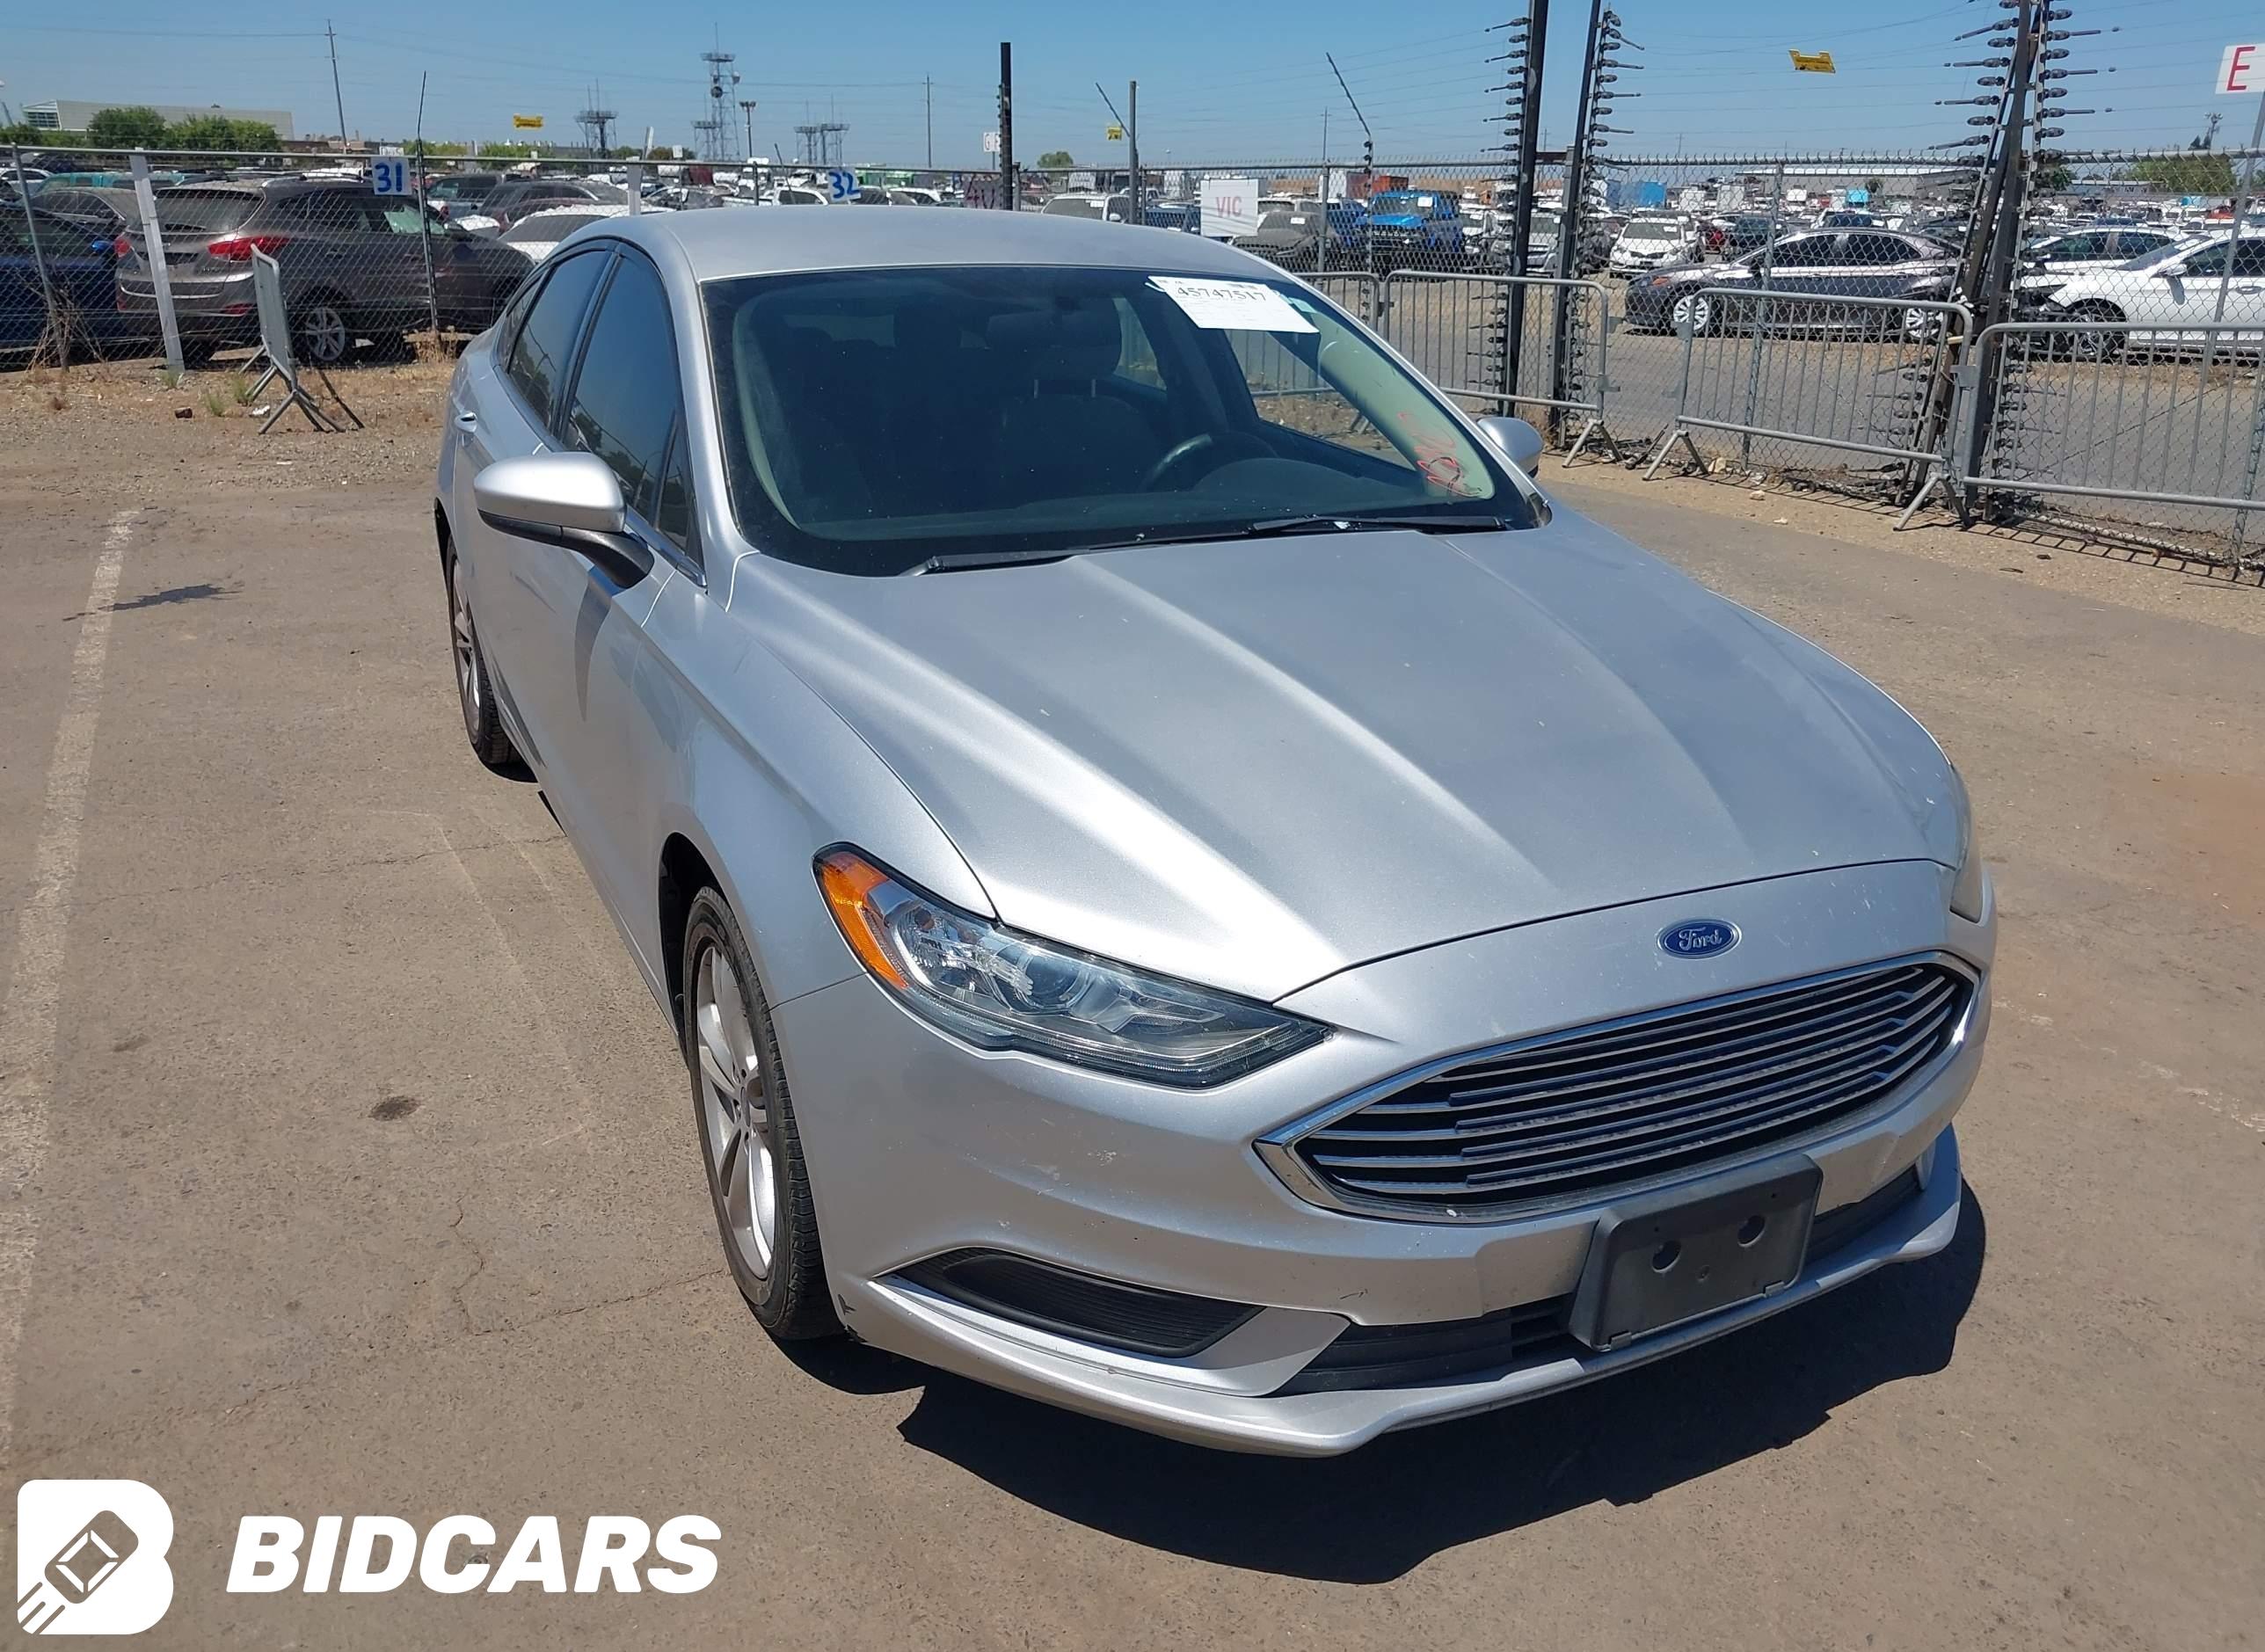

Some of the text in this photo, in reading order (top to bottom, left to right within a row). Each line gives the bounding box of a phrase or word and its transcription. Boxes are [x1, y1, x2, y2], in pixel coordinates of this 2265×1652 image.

[2226, 46, 2256, 91] E
[375, 162, 403, 193] 31
[828, 171, 860, 199] 32
[1215, 195, 1242, 218] VIC
[1177, 287, 1267, 302] 45747517
[1678, 927, 1722, 950] Ford
